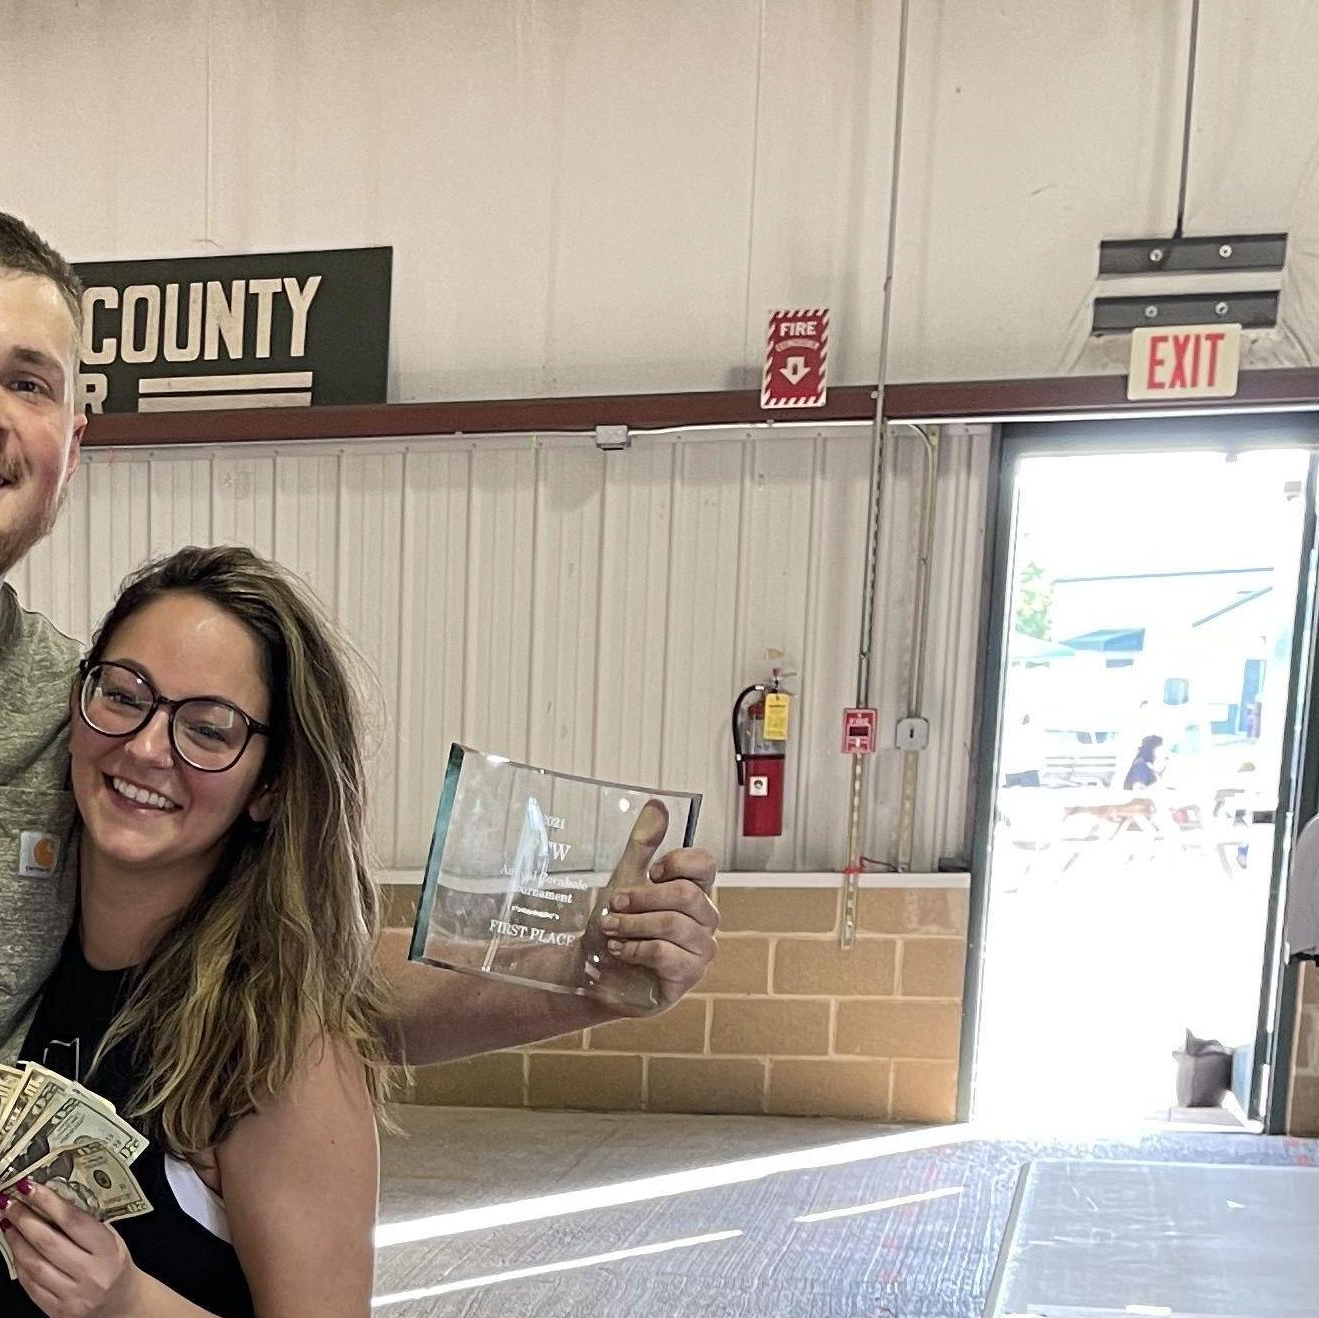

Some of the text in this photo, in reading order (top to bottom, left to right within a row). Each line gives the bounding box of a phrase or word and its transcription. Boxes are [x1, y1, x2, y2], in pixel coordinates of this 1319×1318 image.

[80, 276, 322, 365] COUNTY
[780, 321, 818, 336] FIRE
[1147, 333, 1226, 390] EXIT
[490, 919, 576, 946] FIRST PLACE
